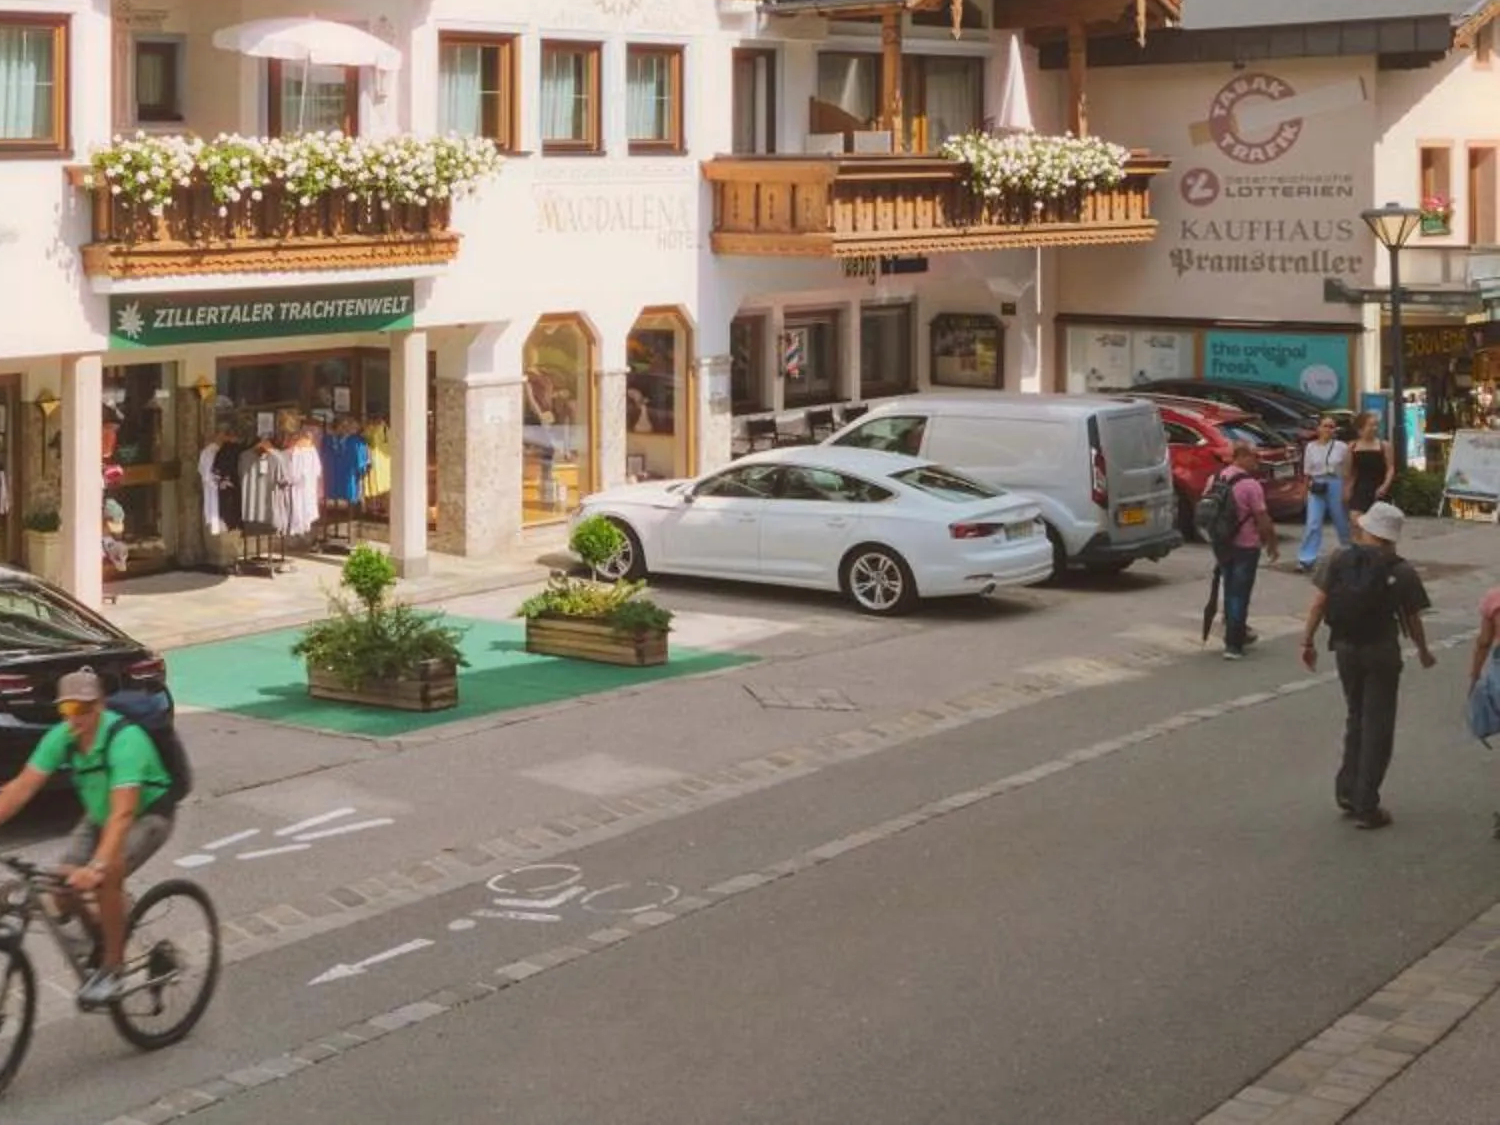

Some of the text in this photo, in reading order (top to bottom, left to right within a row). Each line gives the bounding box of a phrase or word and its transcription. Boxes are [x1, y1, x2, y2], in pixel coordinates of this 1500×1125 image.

[1213, 77, 1285, 118] TABAK
[1219, 122, 1299, 162] TRAFIK
[1225, 185, 1353, 198] LOTTERIEN
[536, 194, 691, 233] MAGDALENA
[1179, 219, 1355, 242] KAUFHAUS
[1168, 247, 1364, 278] Pramstraller
[153, 295, 410, 328] ZILLERTALER TRACHTENWELT
[1211, 341, 1240, 355] the
